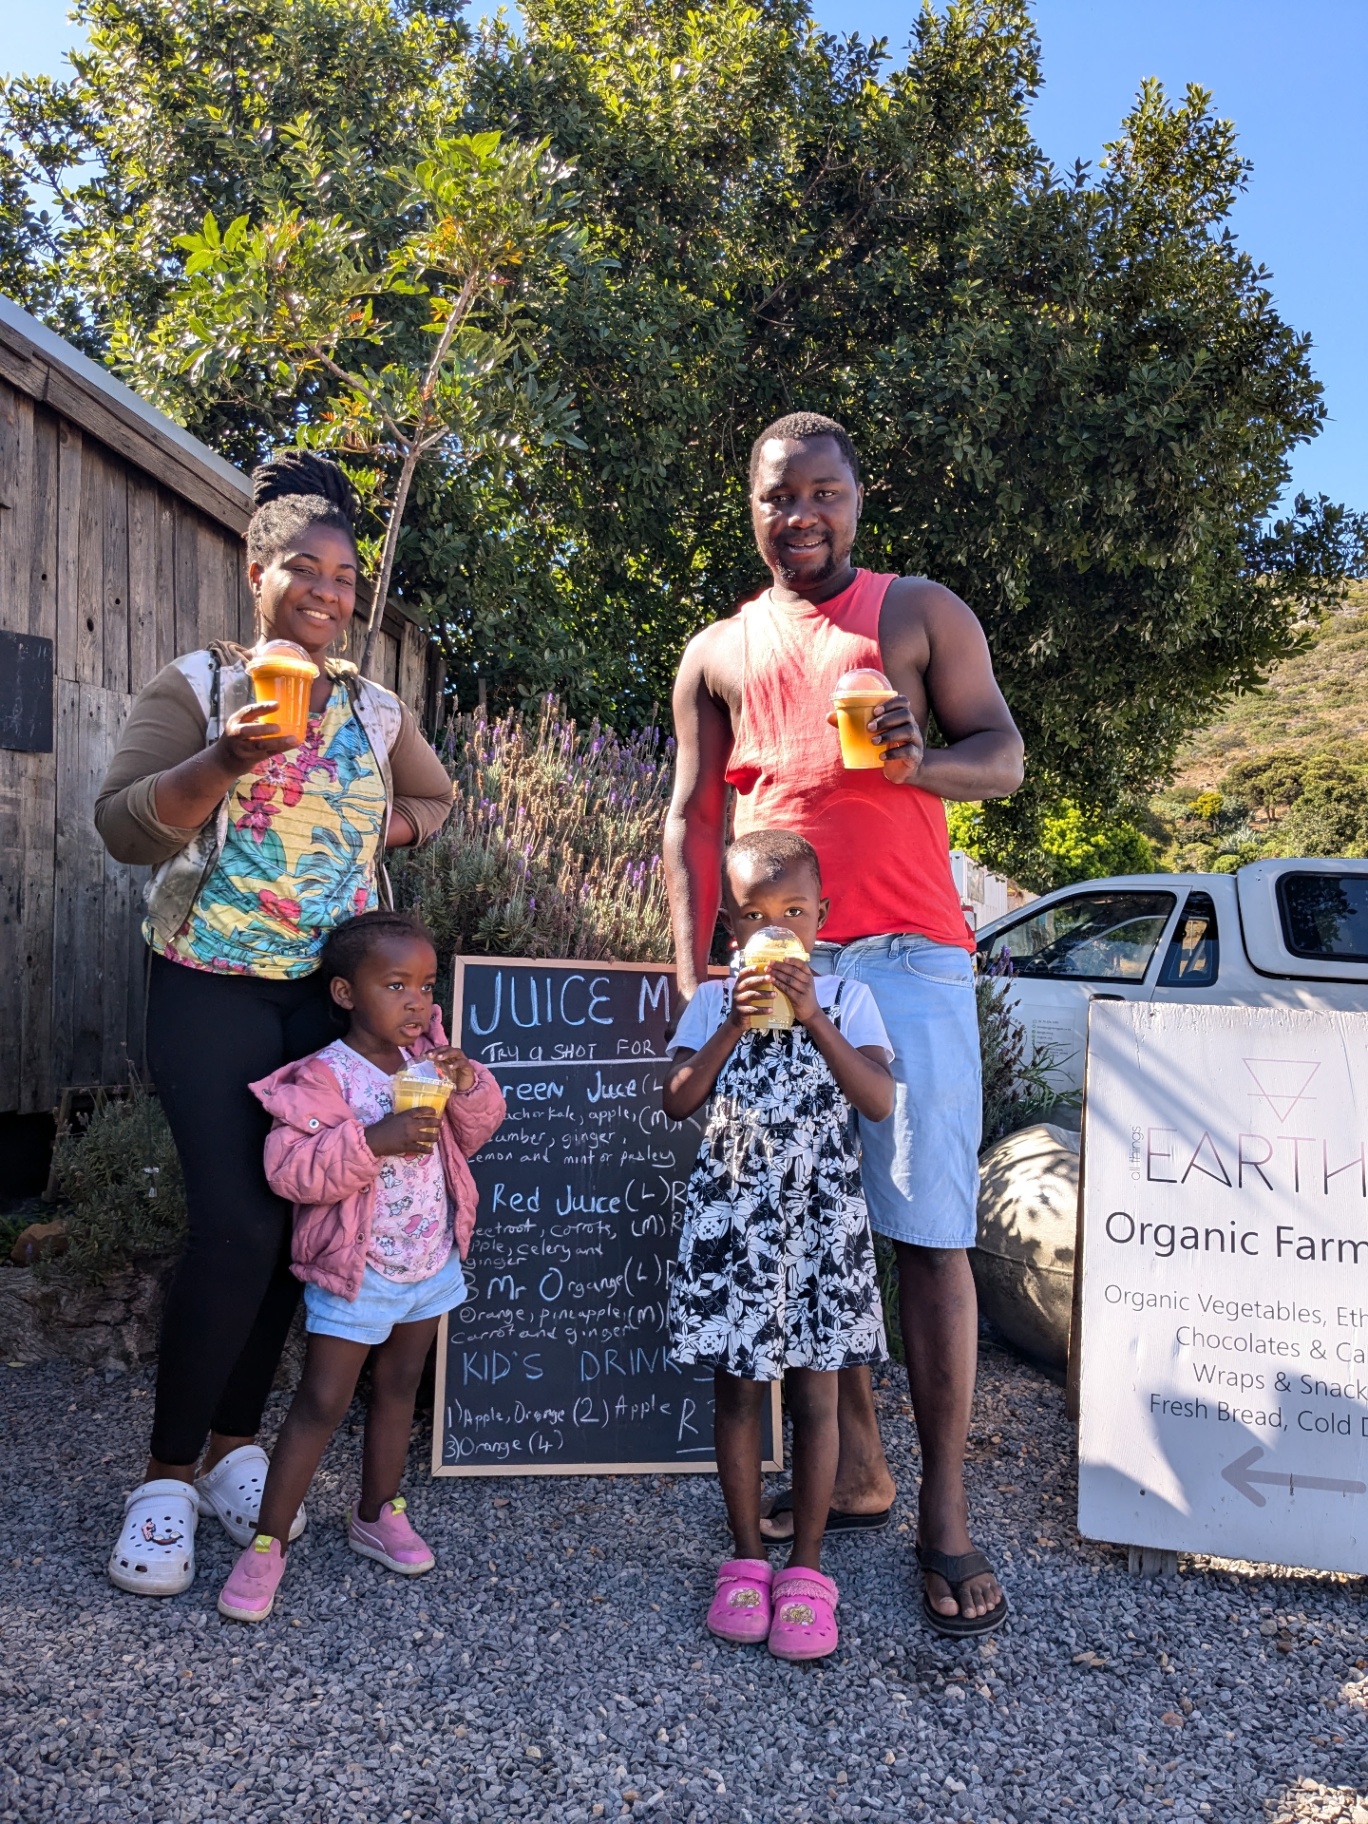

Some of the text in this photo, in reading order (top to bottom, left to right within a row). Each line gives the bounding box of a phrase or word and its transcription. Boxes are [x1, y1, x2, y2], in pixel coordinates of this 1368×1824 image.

[469, 970, 670, 1036] JUICE M
[480, 1041, 520, 1063] TRY
[550, 1042, 598, 1061] SHOT
[616, 1038, 656, 1057] FOR
[501, 1081, 564, 1101] reen
[487, 1127, 556, 1149] umber,
[519, 1147, 551, 1164] and
[563, 1148, 596, 1166] mint
[600, 1152, 613, 1164] or
[1147, 1127, 1368, 1198] EARTH
[492, 1183, 542, 1214] Red
[555, 1184, 621, 1216] Juice
[470, 1238, 513, 1257] pple,
[575, 1242, 604, 1256] and
[1105, 1211, 1368, 1264] Organic Farm
[487, 1274, 527, 1300] Mr
[1104, 1284, 1368, 1328] Organic Vegetables, Eth
[518, 1326, 559, 1340] and
[1176, 1326, 1365, 1364] Chocolates & Ca
[462, 1350, 544, 1386] KID'S
[1193, 1362, 1265, 1393] Wraps
[1274, 1371, 1291, 1393] &
[615, 1394, 672, 1421] Apple
[1150, 1393, 1208, 1420] Fresh
[1217, 1401, 1288, 1432] Bread,
[1297, 1410, 1351, 1436] Cold
